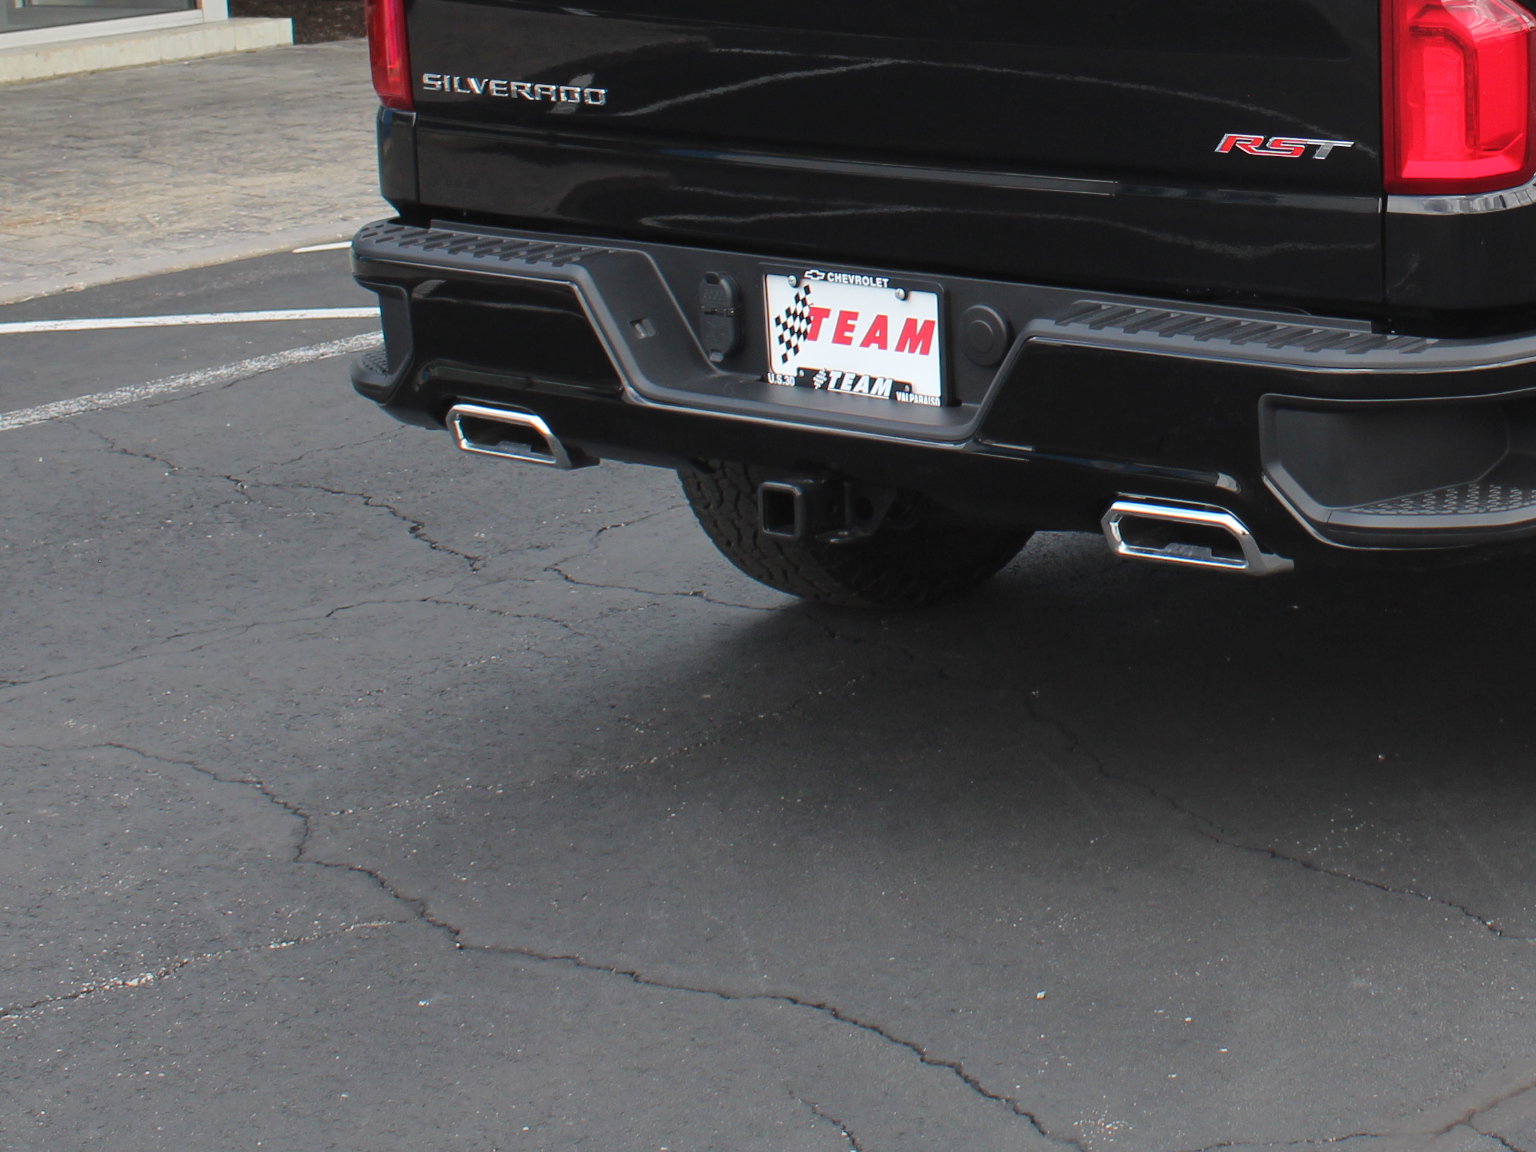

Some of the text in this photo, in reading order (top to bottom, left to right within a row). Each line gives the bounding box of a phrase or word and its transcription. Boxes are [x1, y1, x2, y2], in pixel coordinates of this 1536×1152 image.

[422, 73, 608, 106] SILVERADO
[1214, 133, 1355, 160] RST
[827, 272, 889, 288] CHEVROLET
[806, 306, 936, 356] TEAM
[828, 370, 893, 398] TEAM
